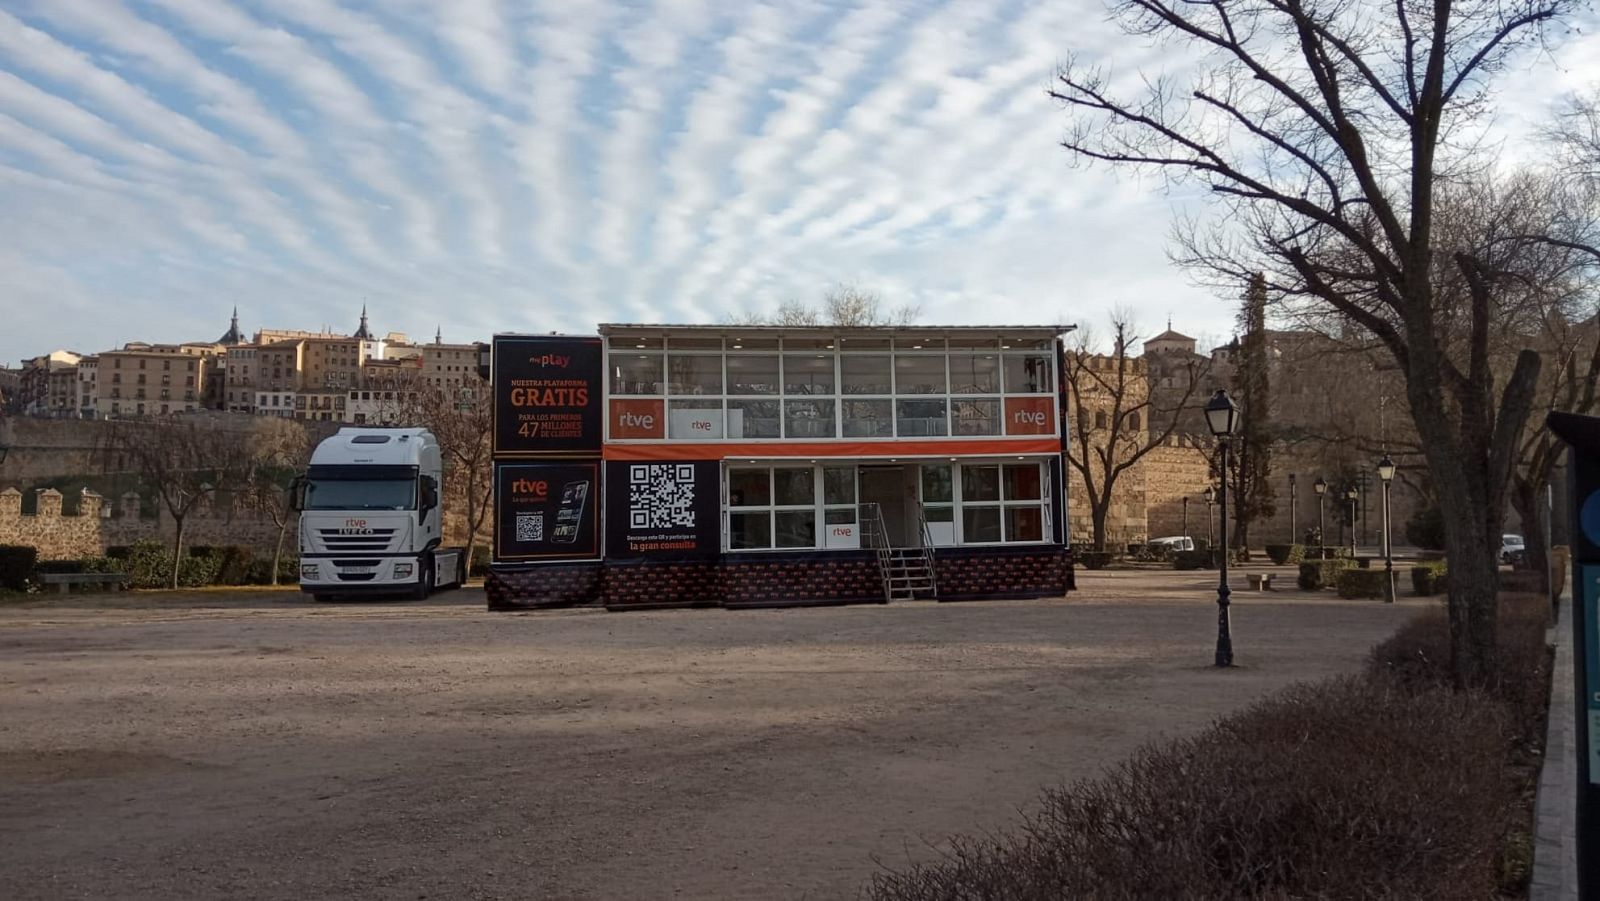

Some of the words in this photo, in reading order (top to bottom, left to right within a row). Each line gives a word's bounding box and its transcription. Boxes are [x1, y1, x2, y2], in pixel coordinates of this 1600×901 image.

[542, 354, 571, 368] play
[511, 388, 588, 407] GRATIS
[619, 412, 654, 429] rtve
[1014, 409, 1046, 425] rtve
[518, 422, 539, 438] 47
[541, 421, 582, 430] MILLONES
[691, 420, 712, 431] rtve
[512, 478, 548, 496] rtve
[346, 517, 367, 528] rtve
[832, 527, 852, 536] rtve
[630, 542, 638, 550] la
[639, 543, 659, 552] gran
[660, 541, 696, 550] consulta
